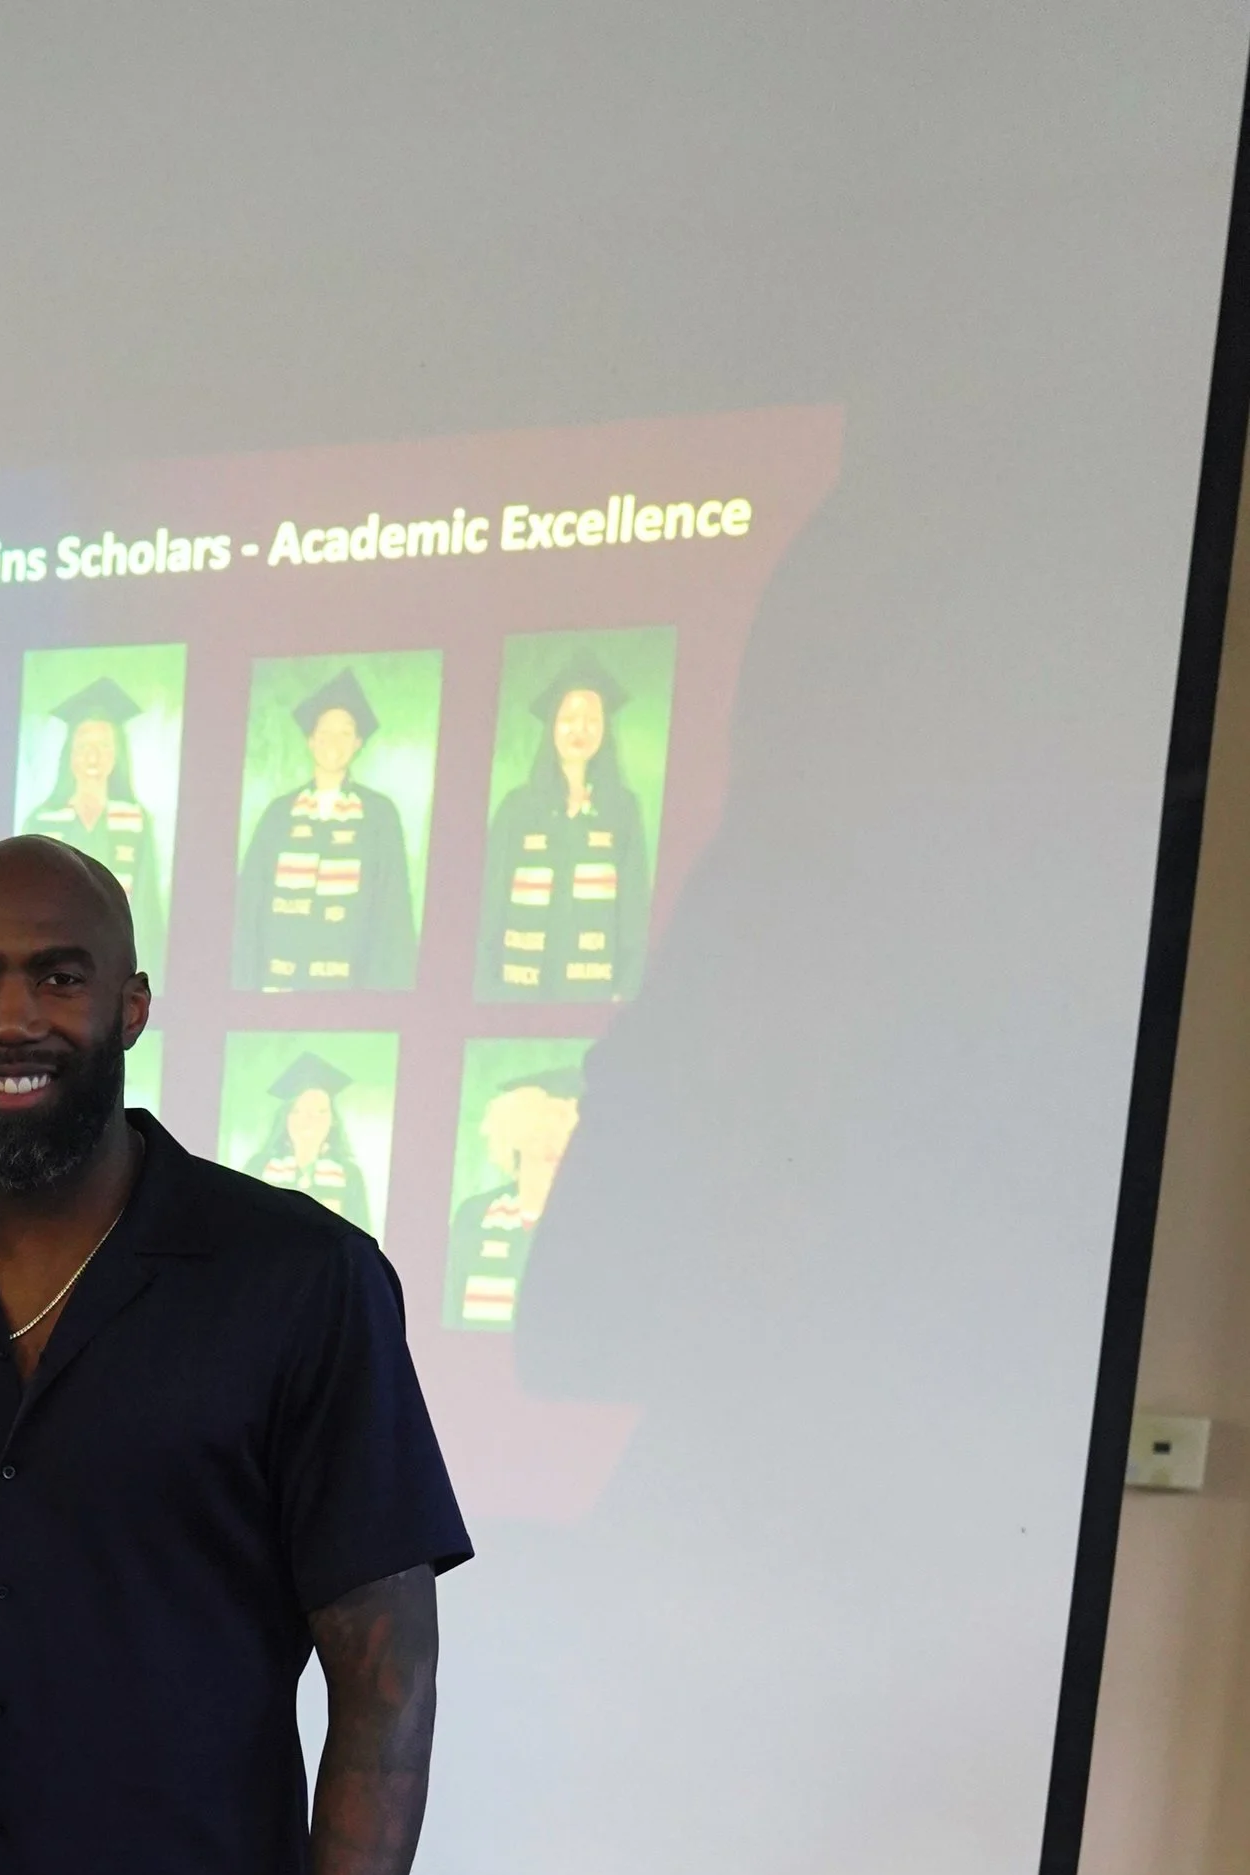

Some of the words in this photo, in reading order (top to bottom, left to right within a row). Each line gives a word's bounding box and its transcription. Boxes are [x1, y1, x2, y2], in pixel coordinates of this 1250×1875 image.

[55, 527, 232, 580] Scholars
[240, 543, 259, 557] -
[267, 507, 490, 567] Academic
[500, 494, 752, 551] Excellence
